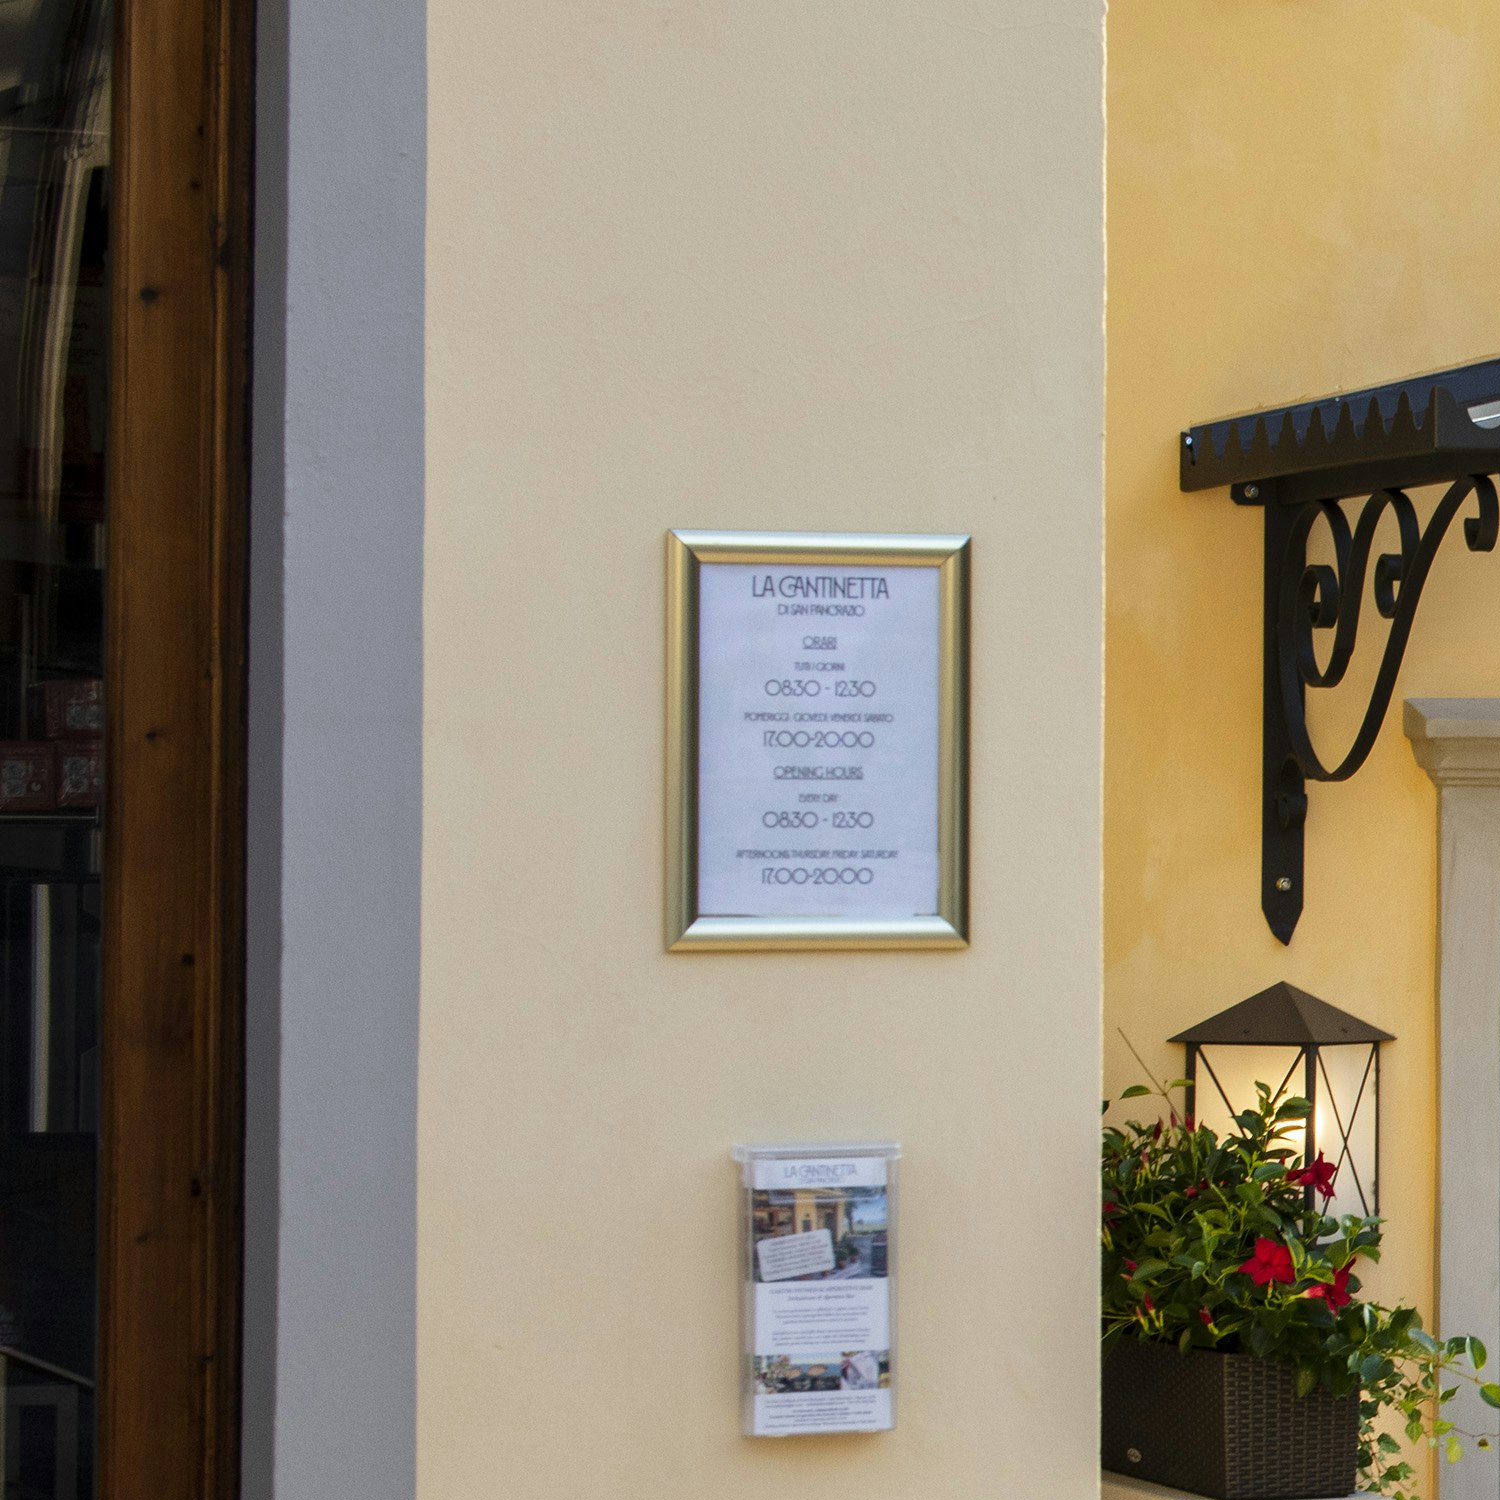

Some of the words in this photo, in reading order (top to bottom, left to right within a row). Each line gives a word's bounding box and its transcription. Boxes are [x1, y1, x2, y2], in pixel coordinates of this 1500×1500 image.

[752, 575, 775, 597] LA
[779, 575, 890, 599] CANTINETTA
[777, 604, 788, 615] DI
[790, 604, 809, 616] SAN
[773, 765, 824, 779] OPENING
[825, 766, 864, 779] HOURS
